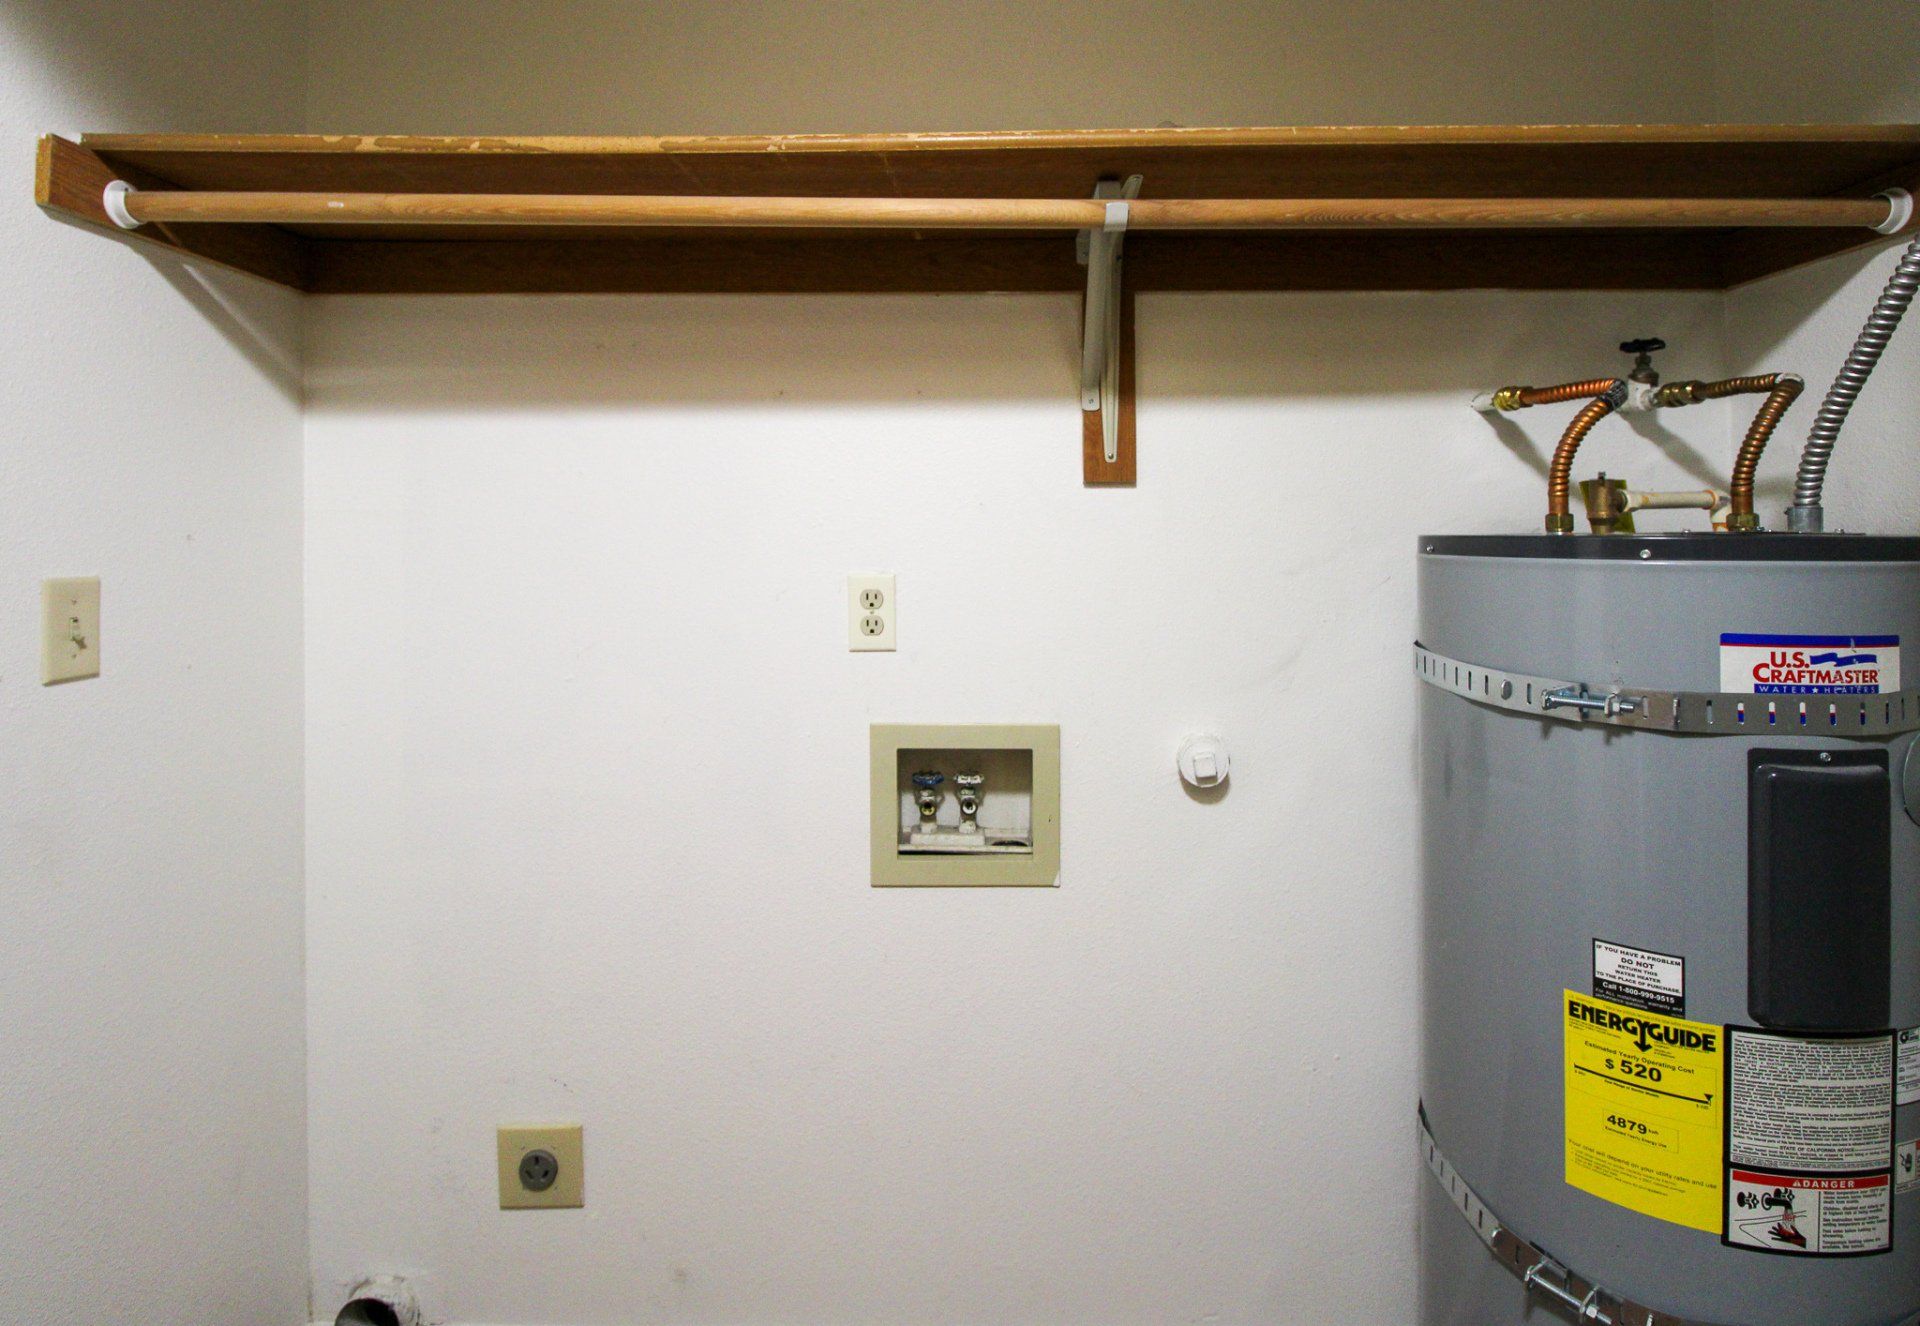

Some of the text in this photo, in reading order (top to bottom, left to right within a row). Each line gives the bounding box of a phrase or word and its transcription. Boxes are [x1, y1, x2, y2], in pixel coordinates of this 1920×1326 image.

[1770, 652, 1810, 668] U.S.
[1753, 663, 1878, 683] CRAFTMASTER
[1620, 950, 1638, 958] HAVE
[1647, 956, 1680, 966] PROBLEM
[1636, 961, 1654, 969] NOT
[1618, 964, 1642, 973] RETURN
[1618, 976, 1637, 985] PLACE
[1637, 975, 1661, 983] HEATER
[1602, 982, 1674, 1004] Call 1-800-999-9515
[1569, 1000, 1716, 1052] ENERGYGUIDE
[1584, 1040, 1695, 1074] Estimated Yearly Operating Cost
[1605, 1058, 1662, 1082] $ 520
[1606, 1114, 1647, 1135] 4879
[1803, 1180, 1855, 1188] DANGER
